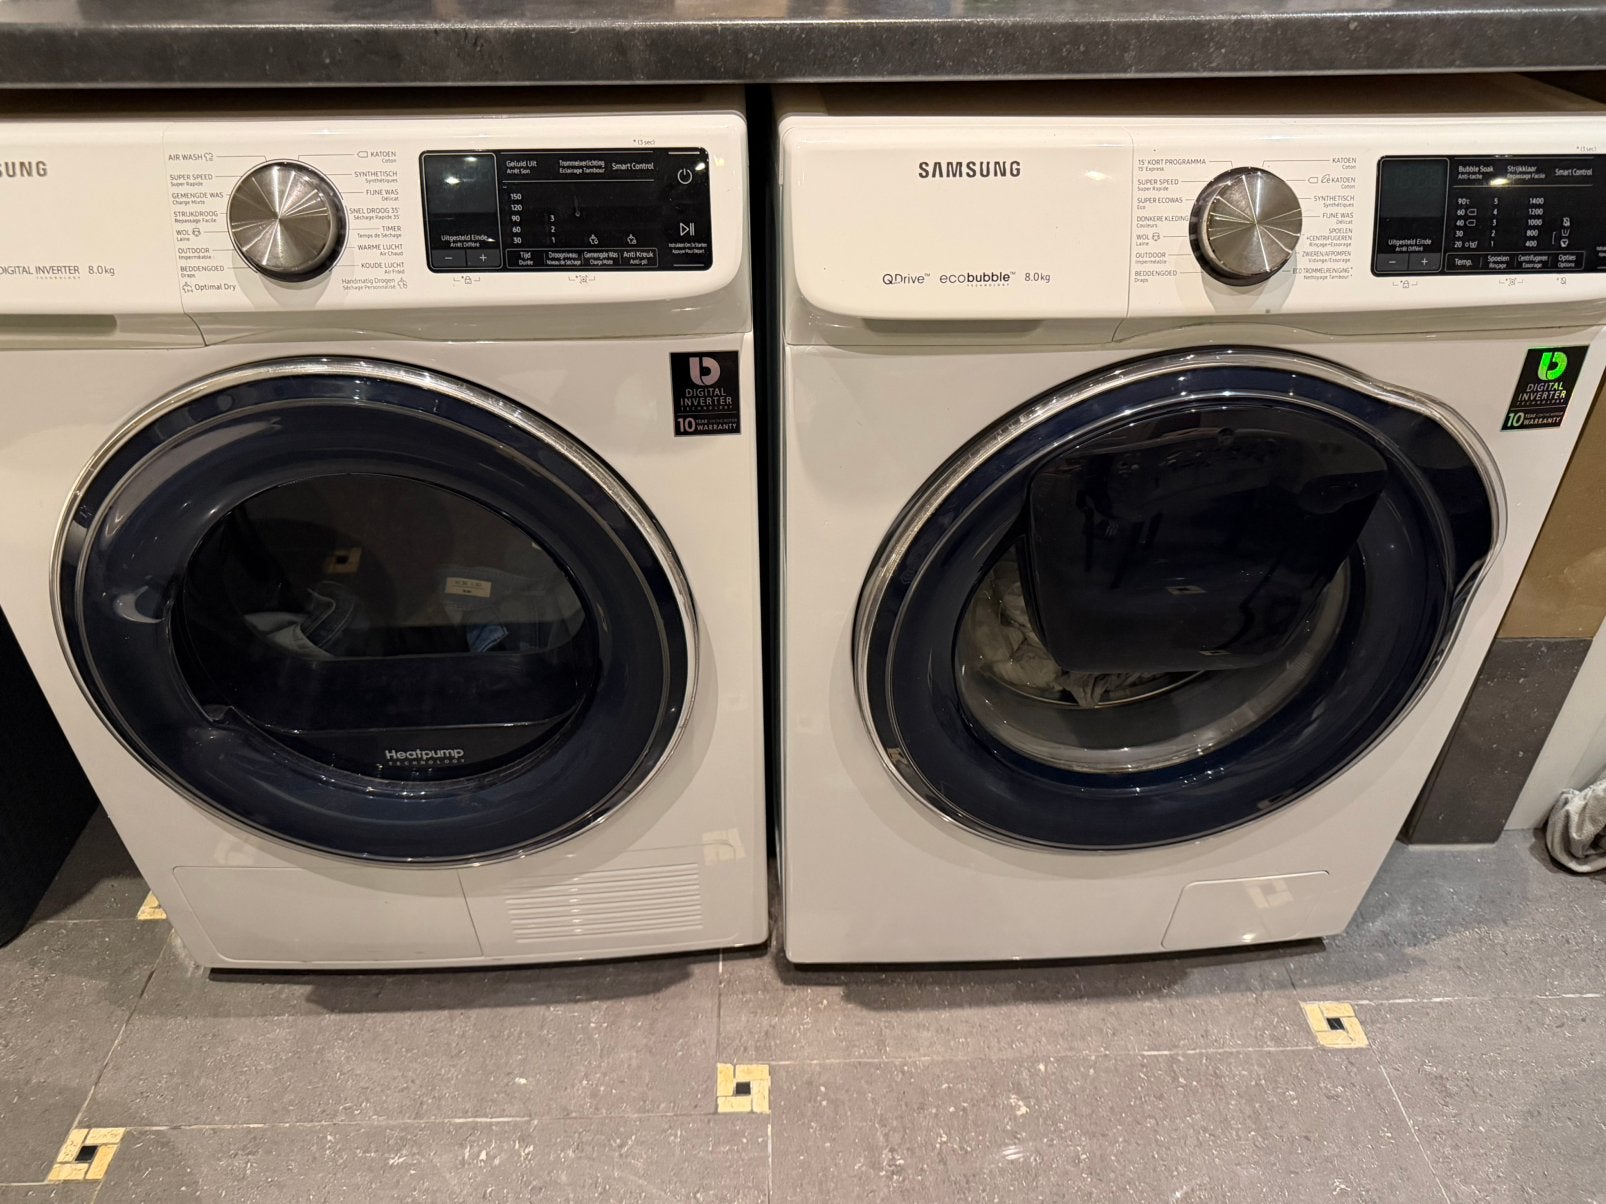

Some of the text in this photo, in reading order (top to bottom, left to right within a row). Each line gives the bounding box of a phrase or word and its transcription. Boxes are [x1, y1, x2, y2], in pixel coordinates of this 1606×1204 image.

[0, 160, 48, 178] UNG
[918, 160, 1021, 178] SAMSUNG
[35, 265, 80, 275] INVERTER
[1527, 382, 1563, 392] DIGITAL
[686, 388, 726, 397] DIGITAL
[1519, 390, 1567, 401] INVERTER
[680, 397, 732, 406] INVERTER
[677, 417, 696, 432] 10
[1507, 412, 1524, 427] 10
[385, 749, 464, 759] Heatpump
